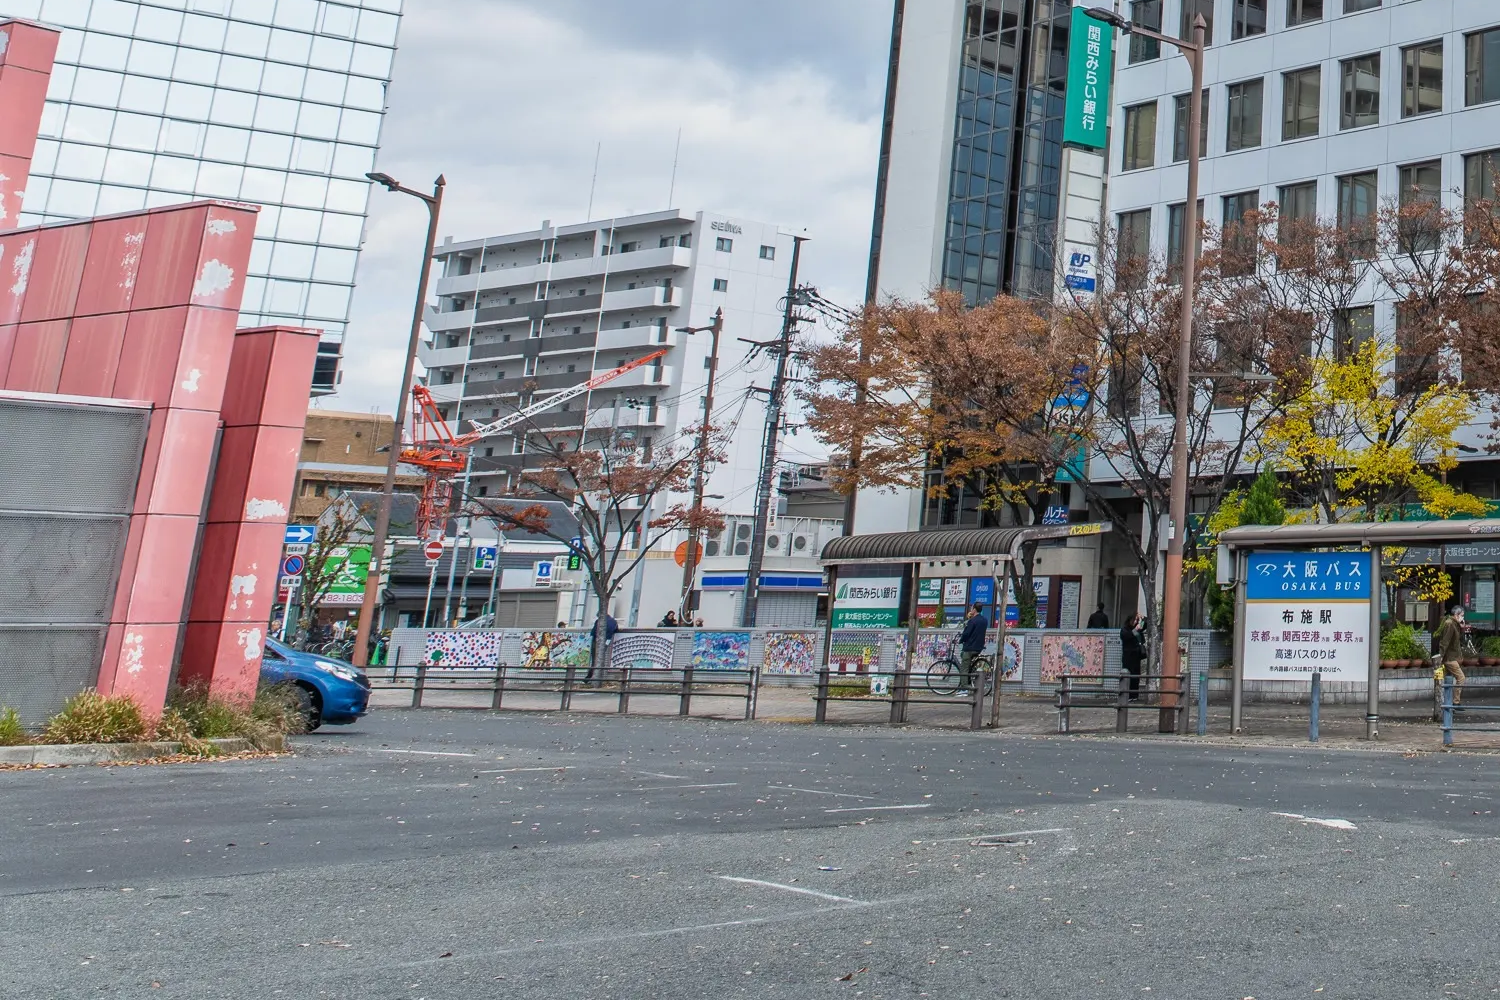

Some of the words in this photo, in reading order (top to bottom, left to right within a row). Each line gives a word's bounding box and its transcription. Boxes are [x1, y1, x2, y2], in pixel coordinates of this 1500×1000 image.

[1082, 24, 1101, 131] 関西みらい銀行
[1069, 523, 1101, 536] バスのりば
[1282, 560, 1362, 578] 大阪バス
[849, 586, 898, 599] 関西みらい銀行
[1281, 581, 1326, 591] OSAKA
[1334, 581, 1361, 591] BUS
[844, 612, 893, 620] 東大阪住宅ローンセンター
[1282, 609, 1332, 624] 布施駅
[1275, 648, 1337, 660] 高速バスのりば
